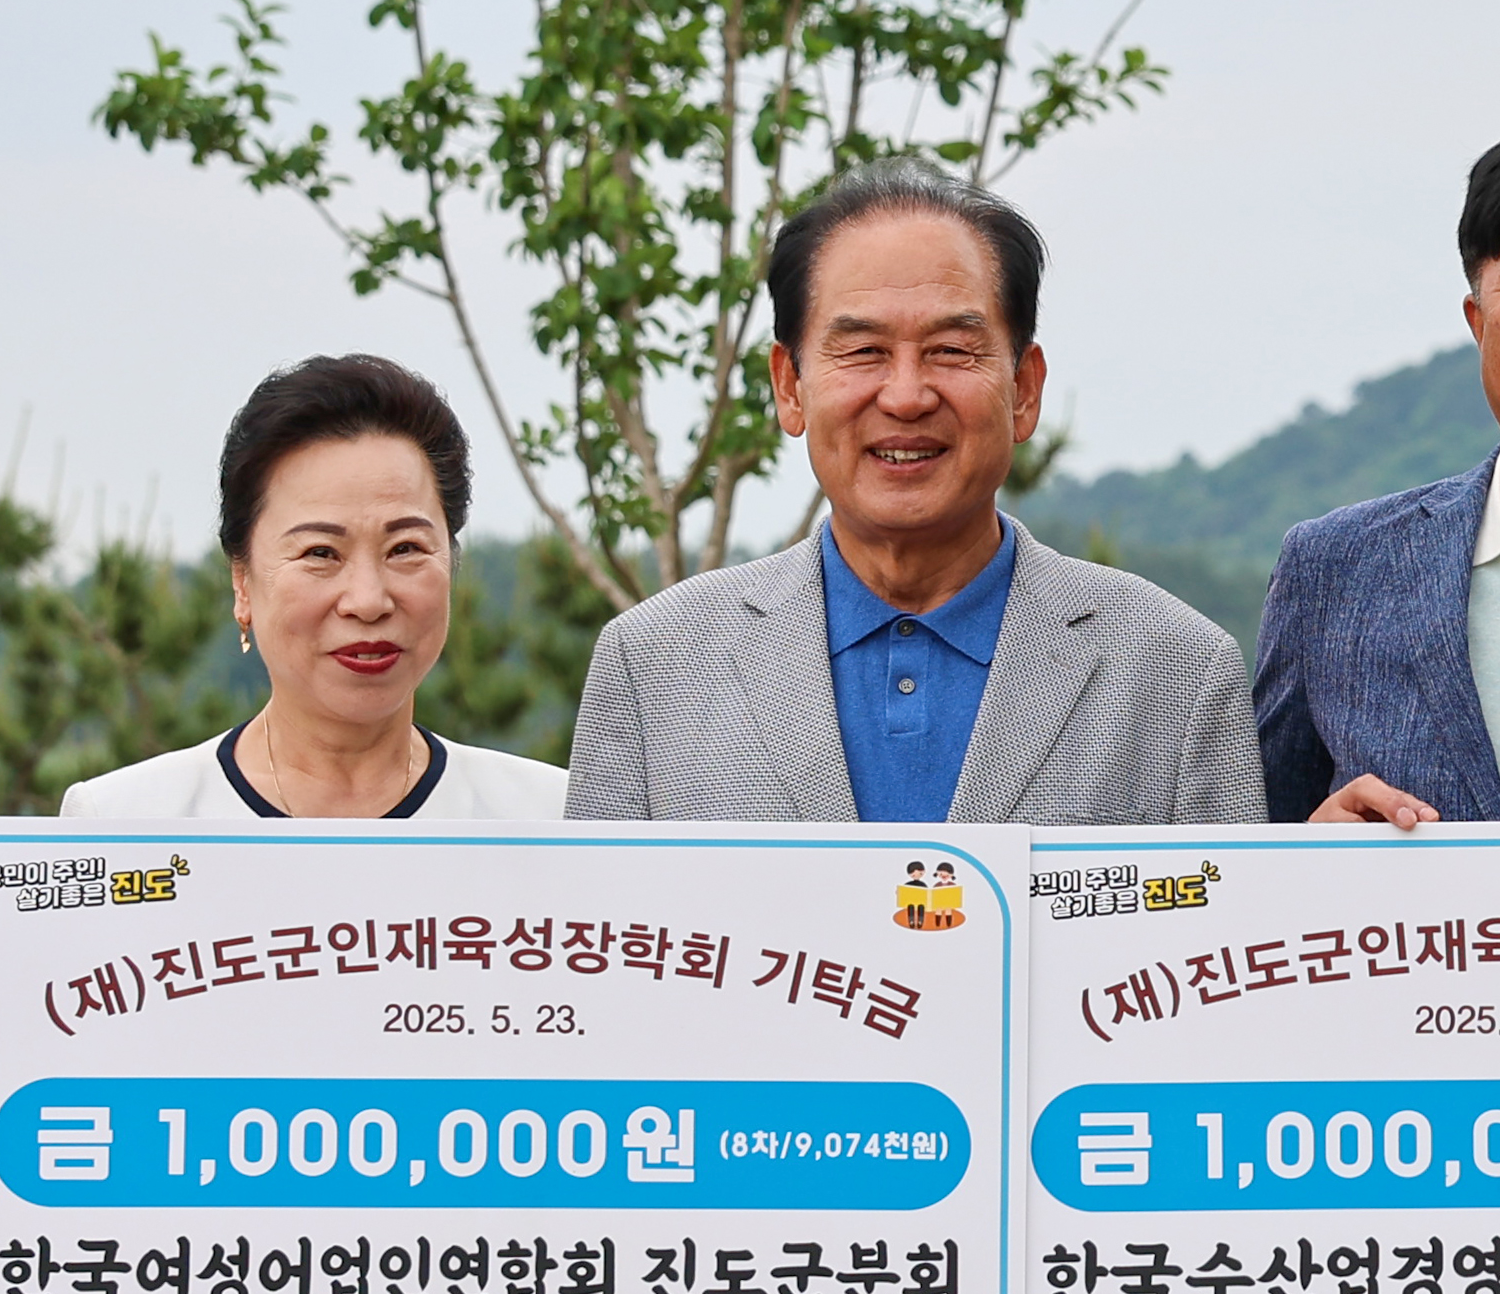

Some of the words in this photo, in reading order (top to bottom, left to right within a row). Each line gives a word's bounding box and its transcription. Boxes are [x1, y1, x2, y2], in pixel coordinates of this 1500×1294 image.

[16, 883, 105, 911] 살기좋은
[111, 869, 176, 904] 진도
[52, 857, 105, 883] 주인!
[1086, 865, 1137, 890] 주인!
[1051, 890, 1138, 920] 살기좋은
[1143, 875, 1208, 911] 진도
[43, 916, 730, 1036] (재)진도군인재육성장학회
[752, 941, 924, 1041] 기탁금
[383, 1005, 478, 1036] 2025.
[489, 1005, 523, 1036] 5.
[535, 1005, 586, 1036] 23.
[36, 1104, 114, 1181] 금
[157, 1104, 698, 1188] 1,000,000원
[719, 1127, 950, 1163] (8차/9,074천원)
[1076, 1112, 1152, 1186] 금
